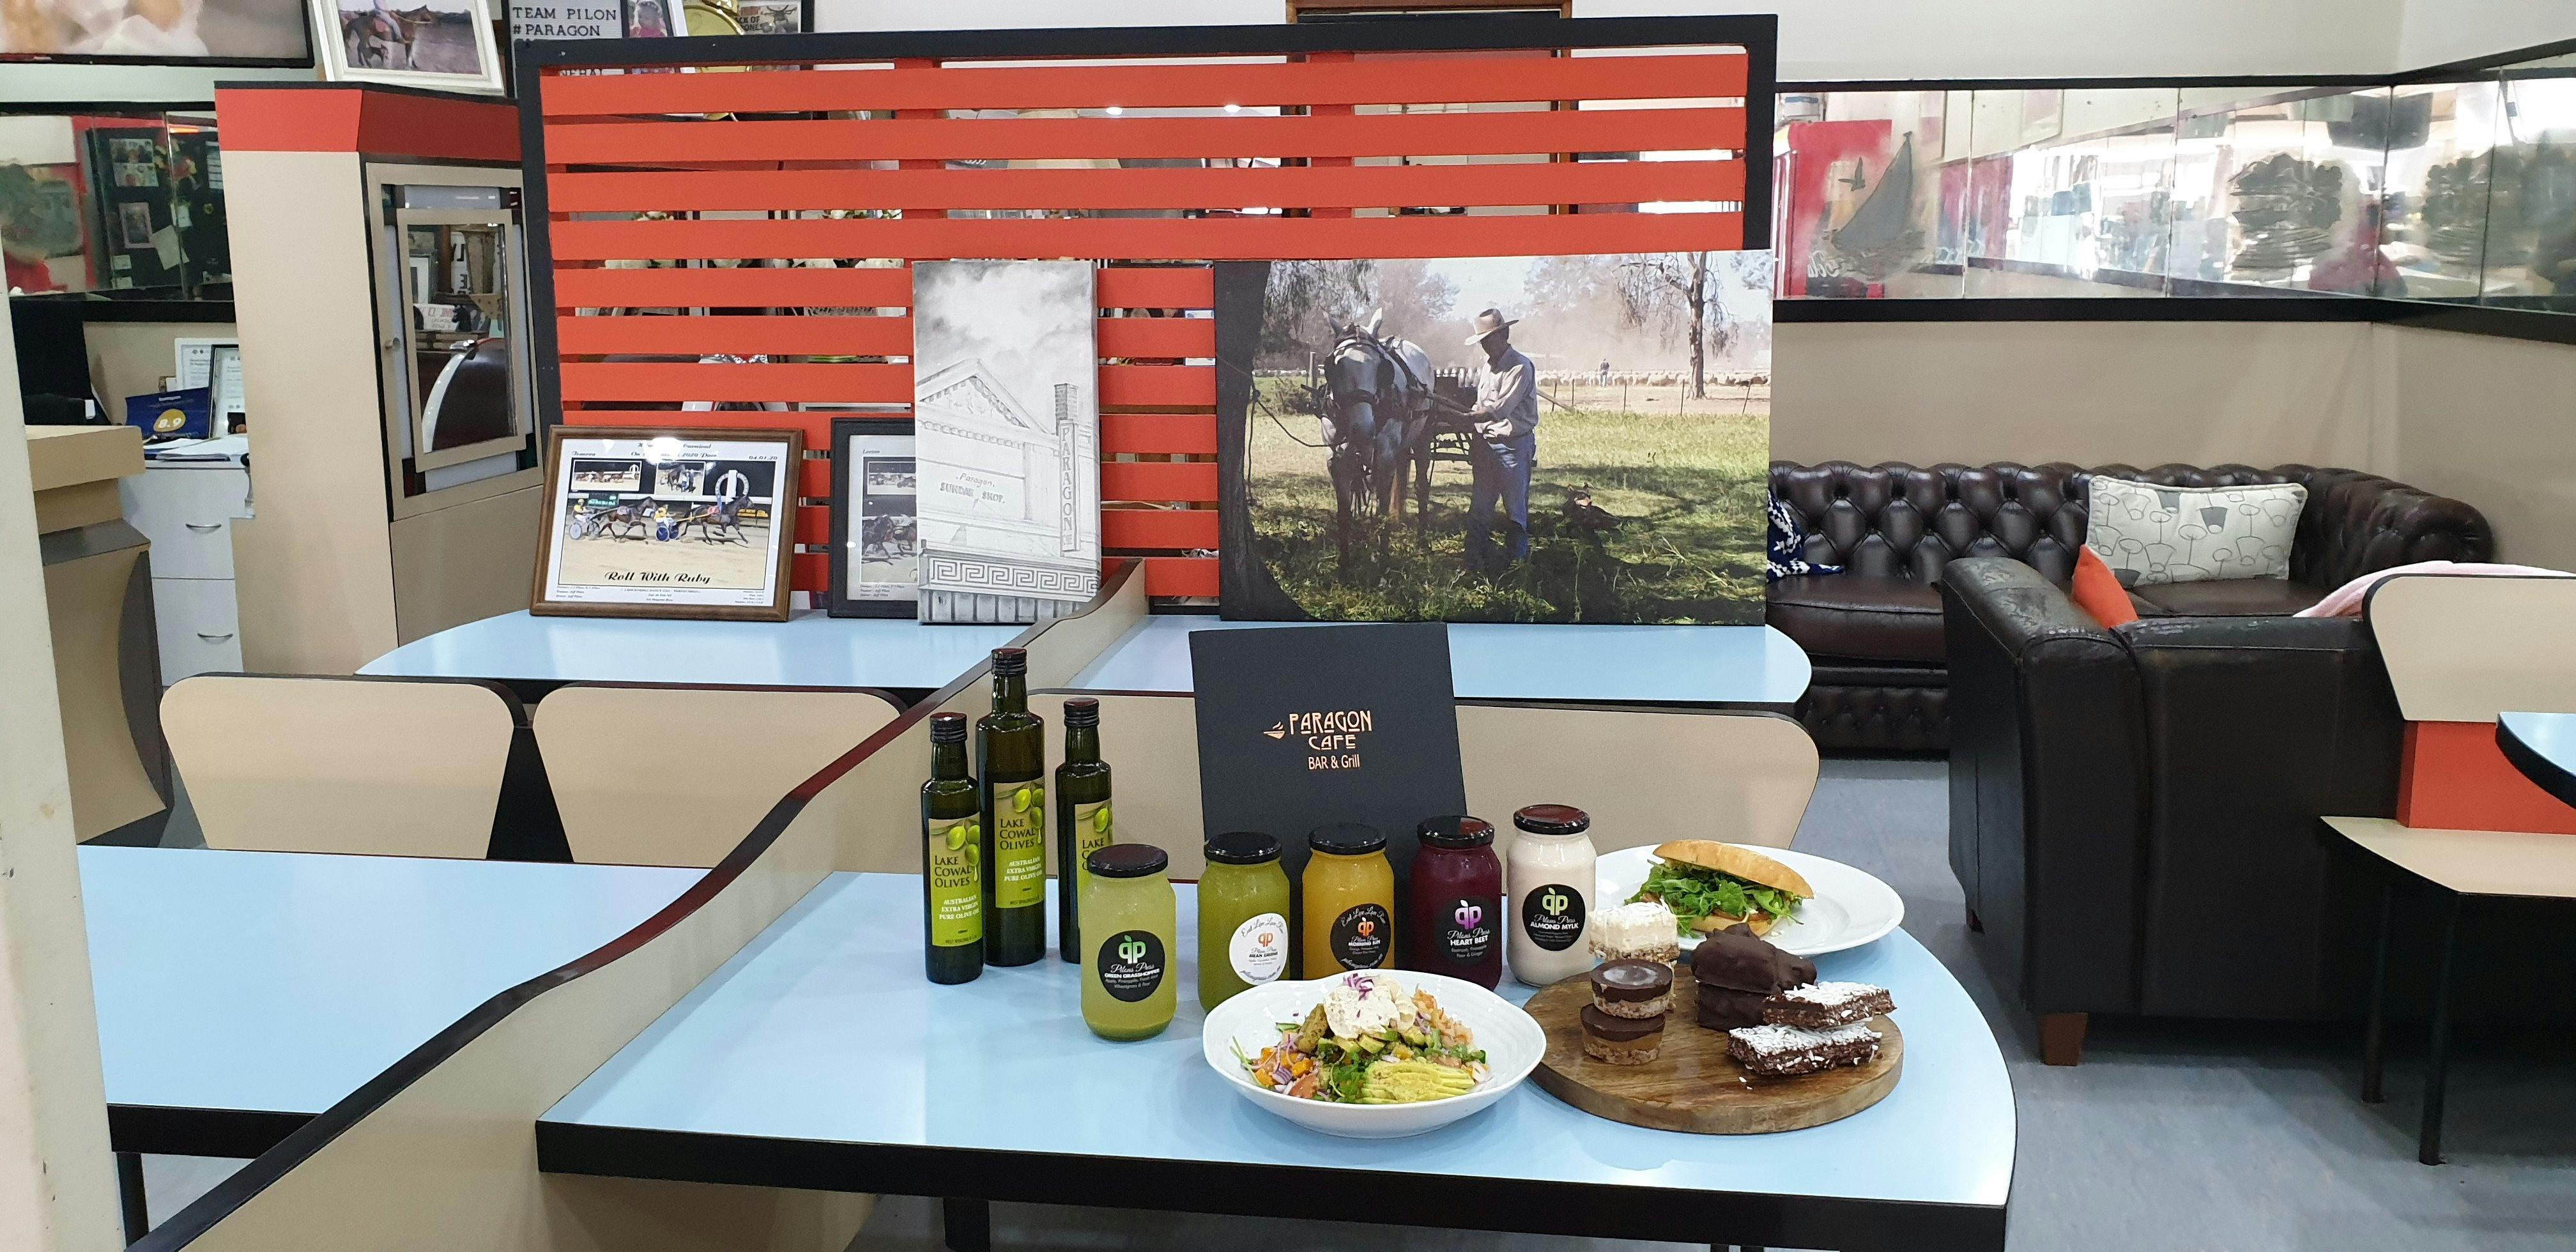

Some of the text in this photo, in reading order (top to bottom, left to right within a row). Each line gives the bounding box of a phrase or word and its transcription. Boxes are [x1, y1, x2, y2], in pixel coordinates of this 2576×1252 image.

[512, 7, 617, 20] TEAM PILON
[1062, 427, 1073, 531] PARAGON
[604, 572, 710, 584] Roll With Ruby
[1289, 710, 1372, 735] PARAGON
[1308, 734, 1356, 750] CAFE
[1308, 754, 1361, 769] BAR & Grill
[1000, 818, 1024, 828] LAKE
[1000, 828, 1035, 839] COWAL
[1000, 839, 1034, 850] OLIVES
[1082, 838, 1103, 848] LAKE
[935, 855, 958, 865] LAKE
[1009, 856, 1041, 867] AUSTRALIAN
[934, 866, 971, 876] COWAL
[1020, 872, 1036, 880] OLIVE
[935, 876, 970, 888] OLIVES
[944, 894, 977, 905] AUSTRALIAN
[1530, 921, 1560, 930] ALMOND
[1475, 935, 1488, 943] BEET
